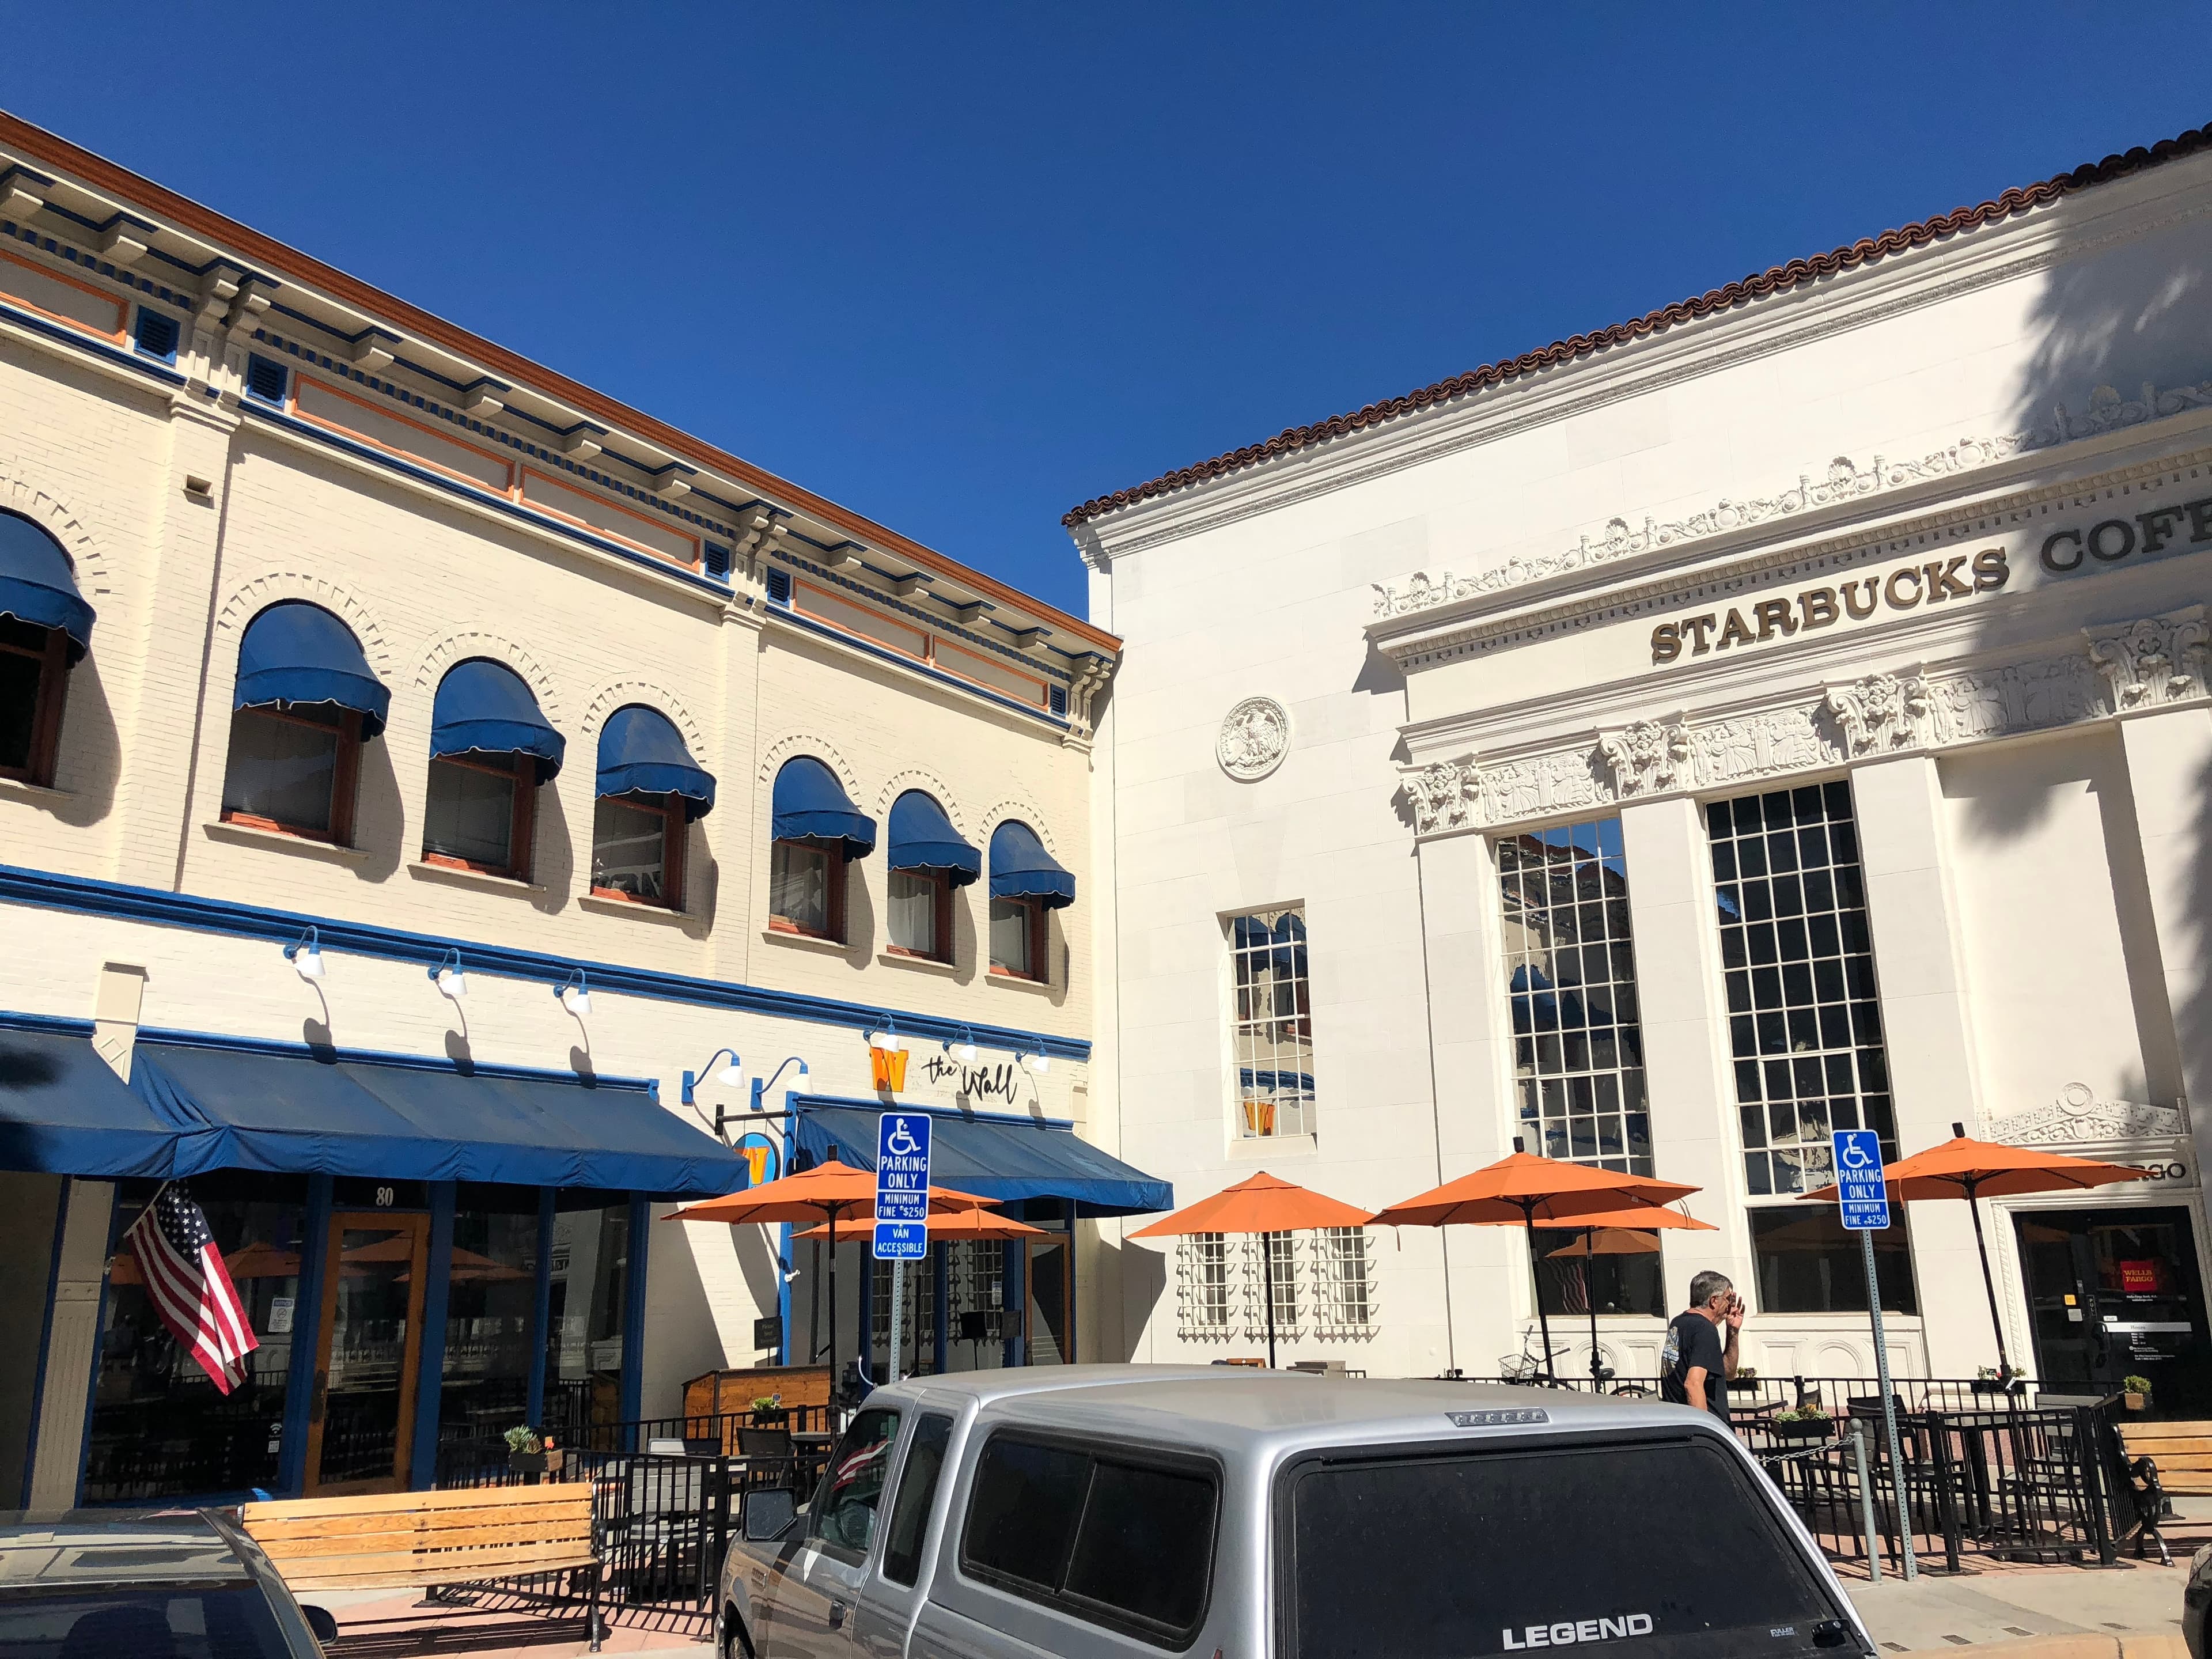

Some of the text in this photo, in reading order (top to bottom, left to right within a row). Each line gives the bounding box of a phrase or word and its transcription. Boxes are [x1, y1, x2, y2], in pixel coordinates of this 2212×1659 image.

[1651, 547, 2010, 665] STARBUCKS
[922, 1055, 1017, 1104] the Wall
[881, 1156, 926, 1172] PARKING
[888, 1173, 918, 1188] ONLY
[1839, 1169, 1881, 1183] PARKING
[376, 1187, 393, 1206] 80
[1849, 1184, 1875, 1198] ONLY
[885, 1194, 919, 1205] MINIMUM
[878, 1206, 924, 1217] FINE $250
[1849, 1203, 1880, 1213] MINIMUM
[1845, 1215, 1887, 1225] FINE $250
[893, 1228, 909, 1238] VAN
[877, 1242, 922, 1253] ACCESSIBLE
[1502, 1613, 1653, 1650] LEGEND
[1770, 1627, 1794, 1637] FULLER
